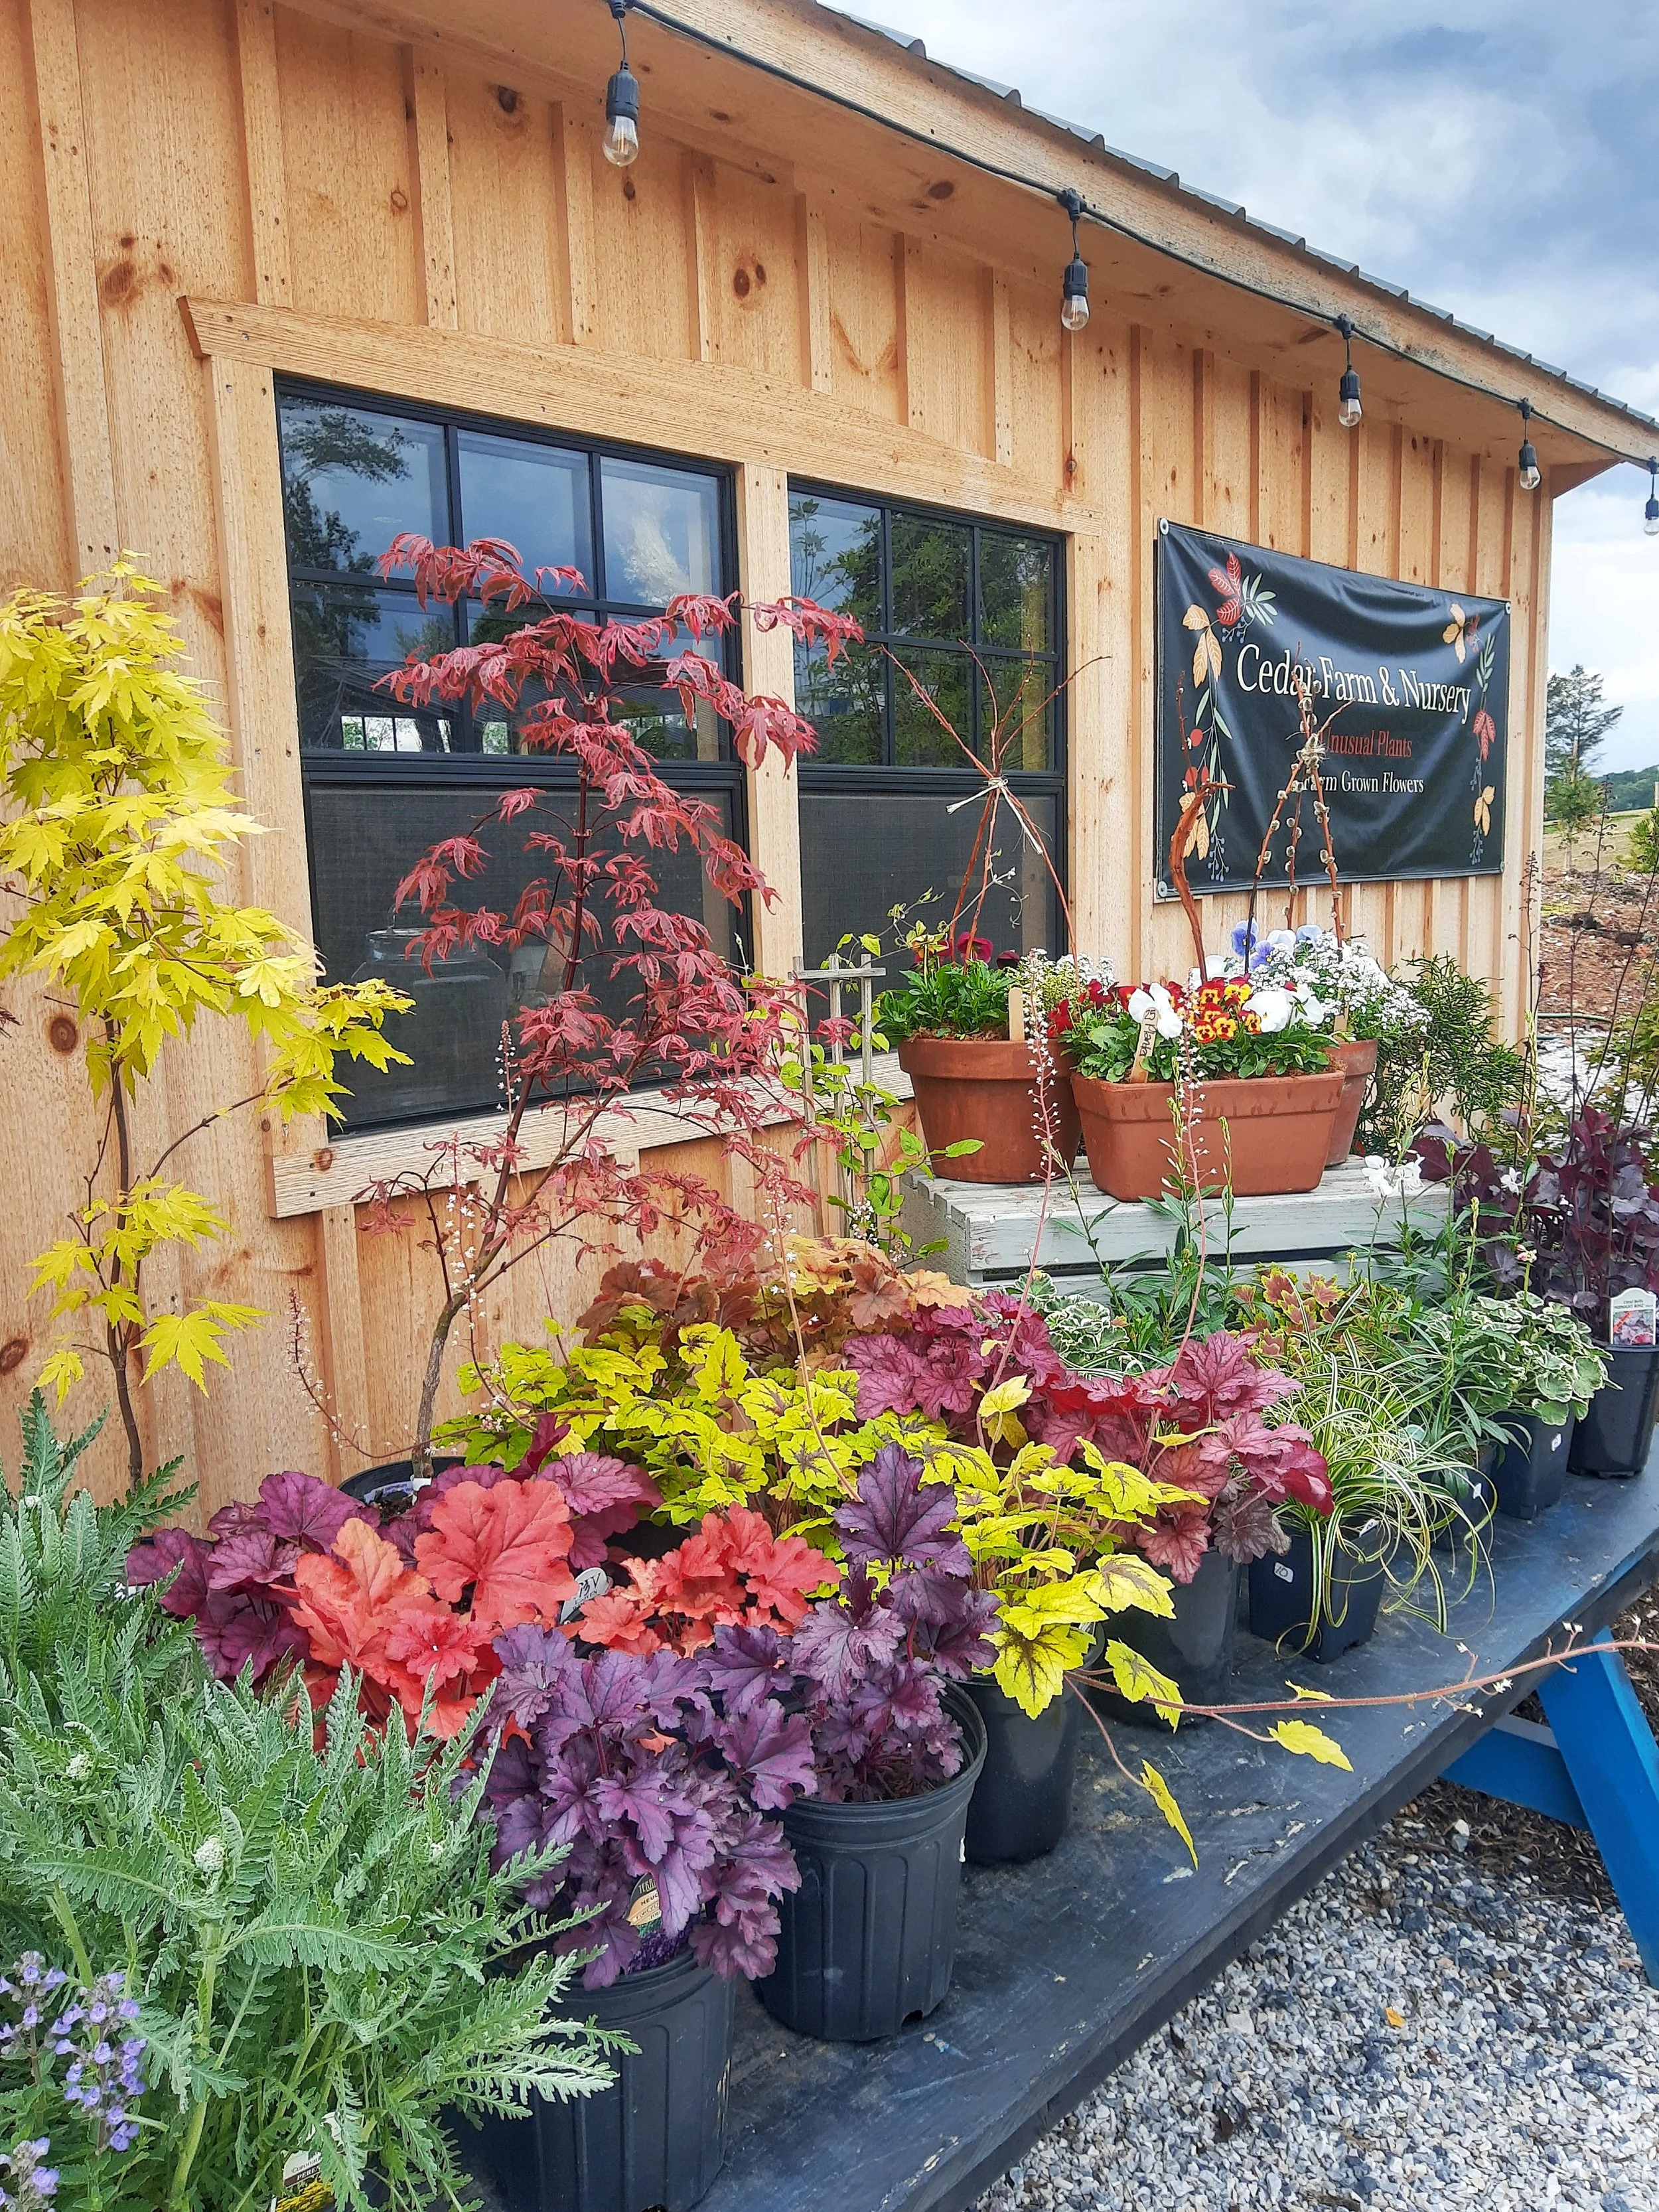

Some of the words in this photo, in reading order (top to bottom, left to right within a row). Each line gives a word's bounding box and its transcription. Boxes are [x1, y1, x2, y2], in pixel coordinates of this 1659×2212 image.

[1237, 643, 1317, 697] Cedar
[1318, 656, 1379, 704] Farm
[1379, 666, 1400, 707] &
[1398, 668, 1472, 725] Nursery
[1376, 730, 1413, 758] Plants
[1341, 770, 1379, 792] Grown
[1382, 771, 1425, 793] Flowers
[1144, 1009, 1156, 1021] 25
[1275, 1566, 1289, 1578] 10
[638, 1878, 657, 1894] TERR
